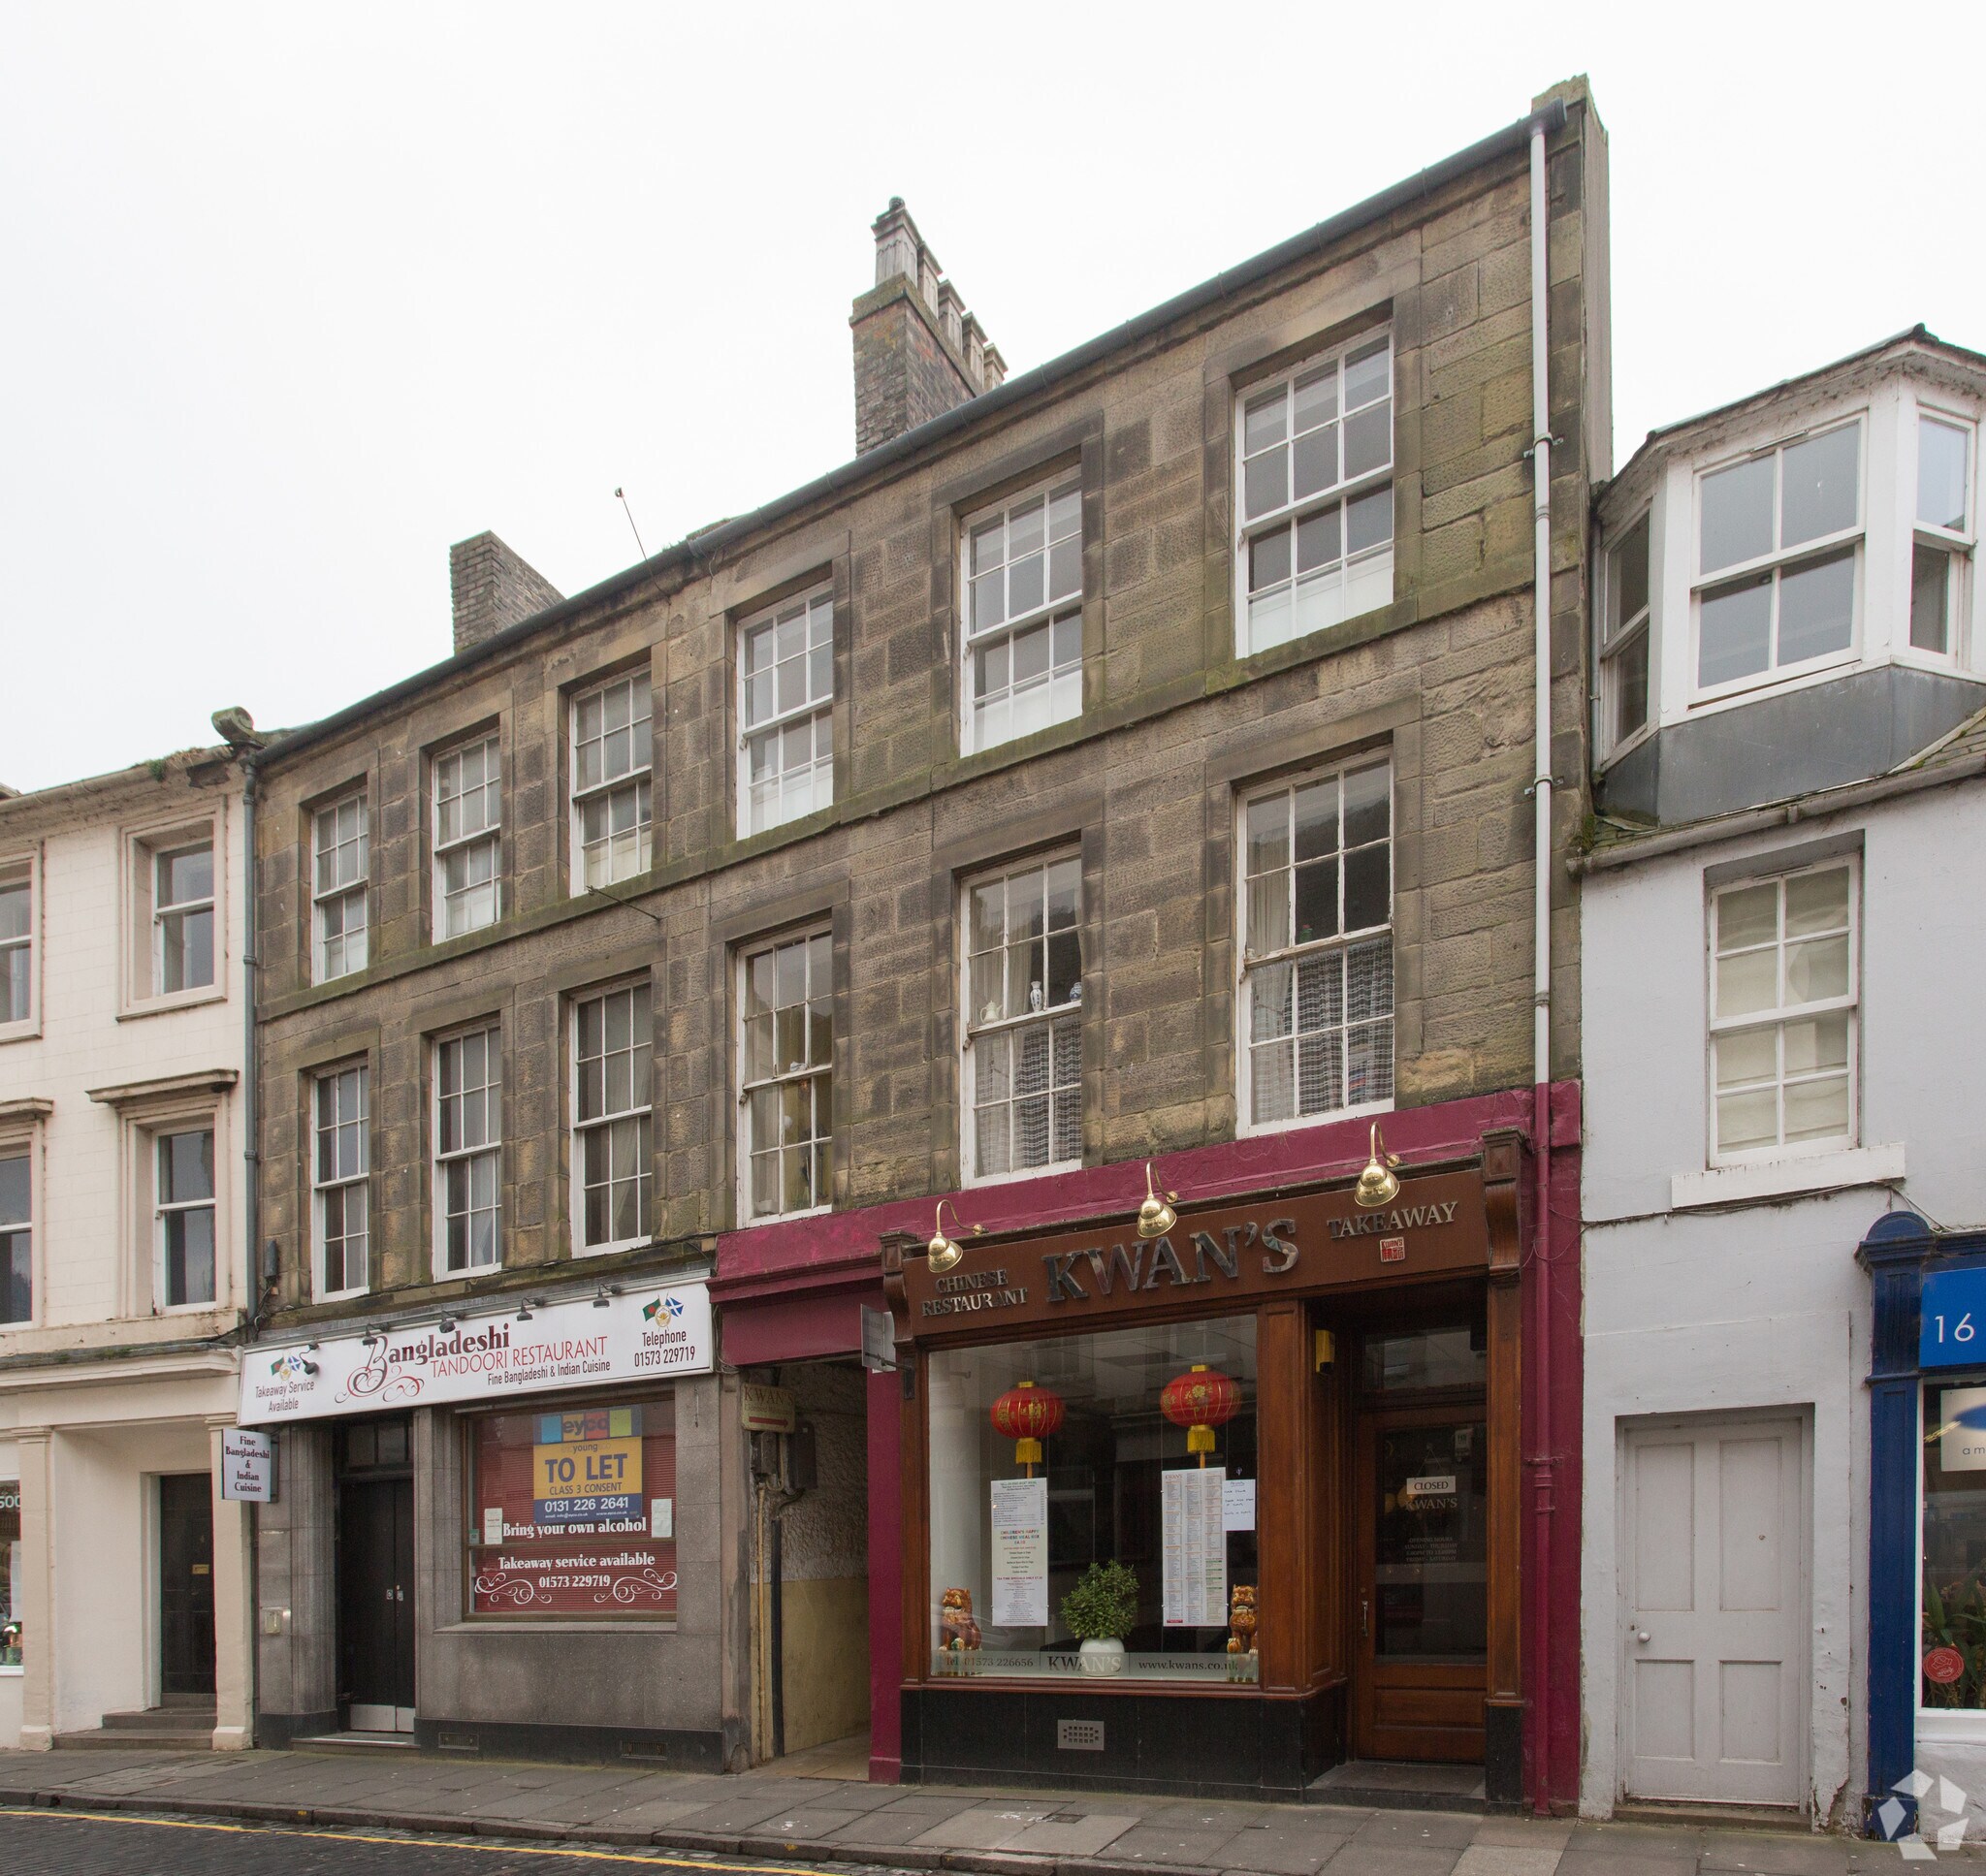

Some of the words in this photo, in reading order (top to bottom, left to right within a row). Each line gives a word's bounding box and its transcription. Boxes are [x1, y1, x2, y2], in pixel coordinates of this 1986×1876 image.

[1327, 1201, 1457, 1239] TAKEAWAY
[1041, 1218, 1299, 1302] KWAN'S
[936, 1269, 1009, 1294] CHINESE
[922, 1288, 1028, 1317] RESTAURANT
[1935, 1313, 1975, 1344] 16
[642, 1330, 687, 1349] Telephone
[353, 1323, 510, 1392] Bangladeshi
[431, 1351, 507, 1378] TANDOORI
[513, 1336, 608, 1367] RESTAURANT
[634, 1351, 660, 1367] 01573
[663, 1346, 695, 1364] 229719
[488, 1371, 502, 1385] Fine
[504, 1364, 548, 1384] Bangladeshi
[550, 1365, 556, 1377] &
[558, 1361, 580, 1376] Indian
[582, 1359, 611, 1374] Cuisine
[255, 1384, 288, 1399] Takeaway
[289, 1380, 314, 1394] Service
[744, 1386, 794, 1406] KWAN'S
[268, 1399, 299, 1413] Available
[240, 1436, 256, 1446] Fine
[573, 1444, 598, 1454] young
[225, 1446, 271, 1459] Bangladeshi
[244, 1459, 251, 1469] &
[544, 1457, 576, 1483] TO
[586, 1453, 627, 1480] LET
[237, 1471, 260, 1481] Indian
[235, 1482, 262, 1492] Cuisine
[549, 1485, 573, 1495] CLASS
[584, 1482, 623, 1493] CONSENT
[1414, 1480, 1449, 1491] CLOSED
[544, 1500, 569, 1512] 0131
[573, 1499, 596, 1510] 226
[600, 1497, 629, 1510] 2641
[1406, 1497, 1457, 1510] KWAN'S
[503, 1522, 534, 1539] Bring
[537, 1524, 565, 1538] your
[568, 1522, 594, 1534] own
[597, 1517, 647, 1532] alcohol
[498, 1556, 553, 1571] Takeaway
[556, 1553, 596, 1567] service
[599, 1552, 656, 1566] available
[539, 1575, 569, 1588] 01573
[572, 1574, 611, 1588] 229719
[964, 1657, 994, 1667] 01573
[996, 1658, 1034, 1667] 226656
[1047, 1655, 1122, 1672] KWAN'S
[1138, 1660, 1238, 1670] www.kwans.co.uk
